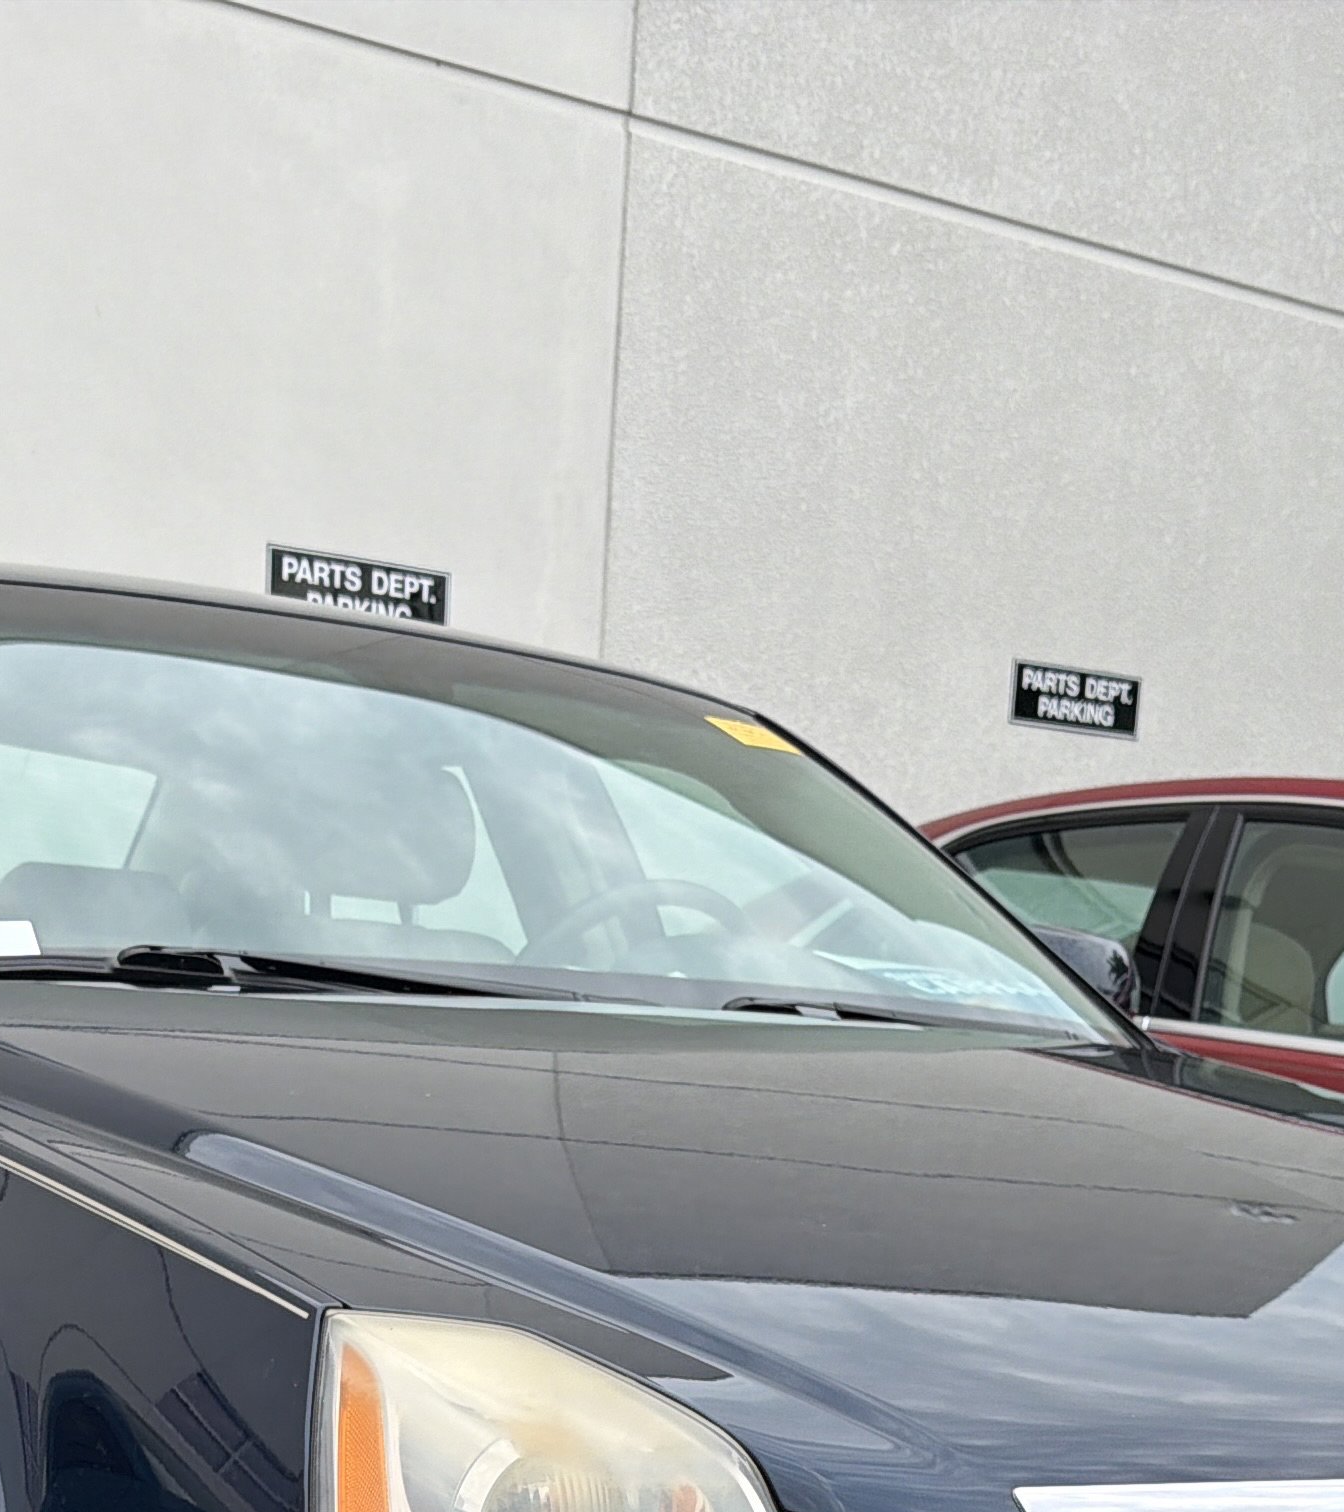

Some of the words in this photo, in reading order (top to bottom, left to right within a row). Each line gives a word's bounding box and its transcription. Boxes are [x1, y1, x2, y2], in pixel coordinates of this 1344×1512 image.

[282, 555, 362, 592] PARTS
[371, 567, 437, 604] DEPT.
[1021, 667, 1081, 697] PARTS
[1037, 694, 1115, 727] PARKING
